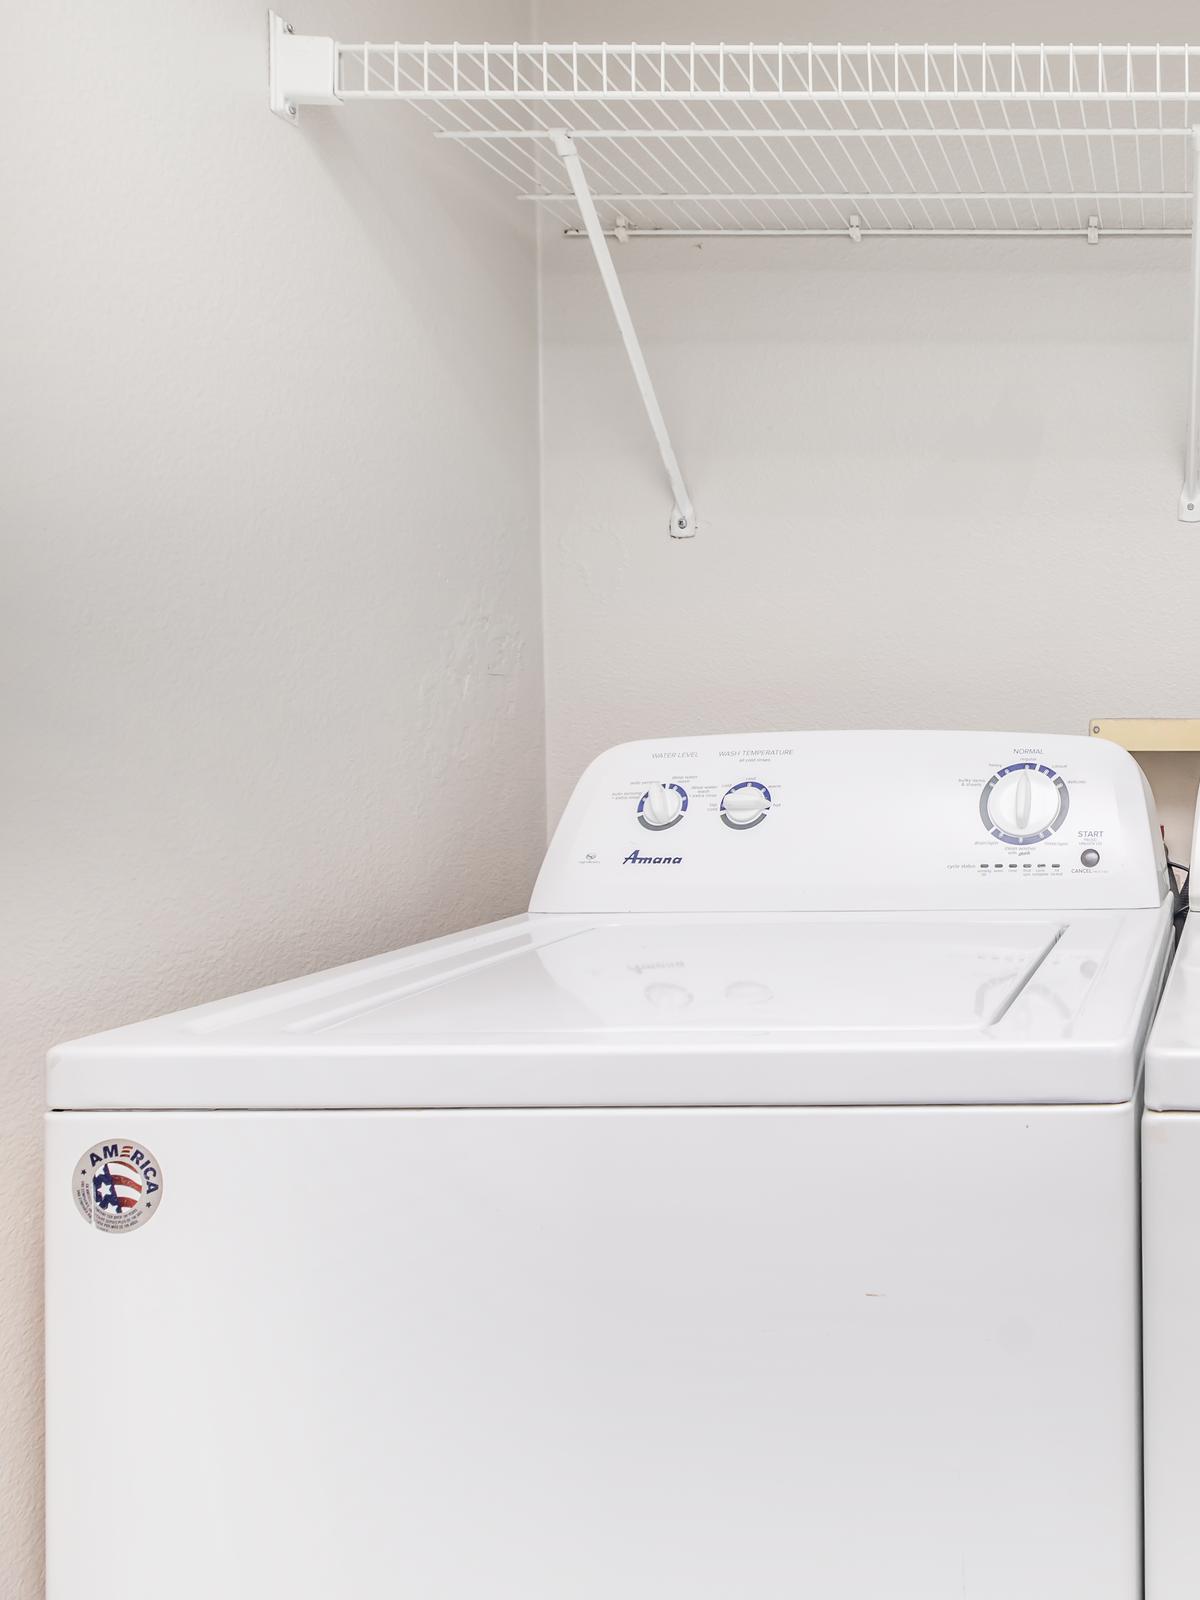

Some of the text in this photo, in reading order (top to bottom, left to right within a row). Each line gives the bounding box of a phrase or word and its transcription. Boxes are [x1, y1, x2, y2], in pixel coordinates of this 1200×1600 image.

[742, 749, 794, 757] TEMPERATURE
[1078, 830, 1104, 838] START
[622, 849, 683, 865] Amana
[89, 1143, 159, 1195] AMERICA
